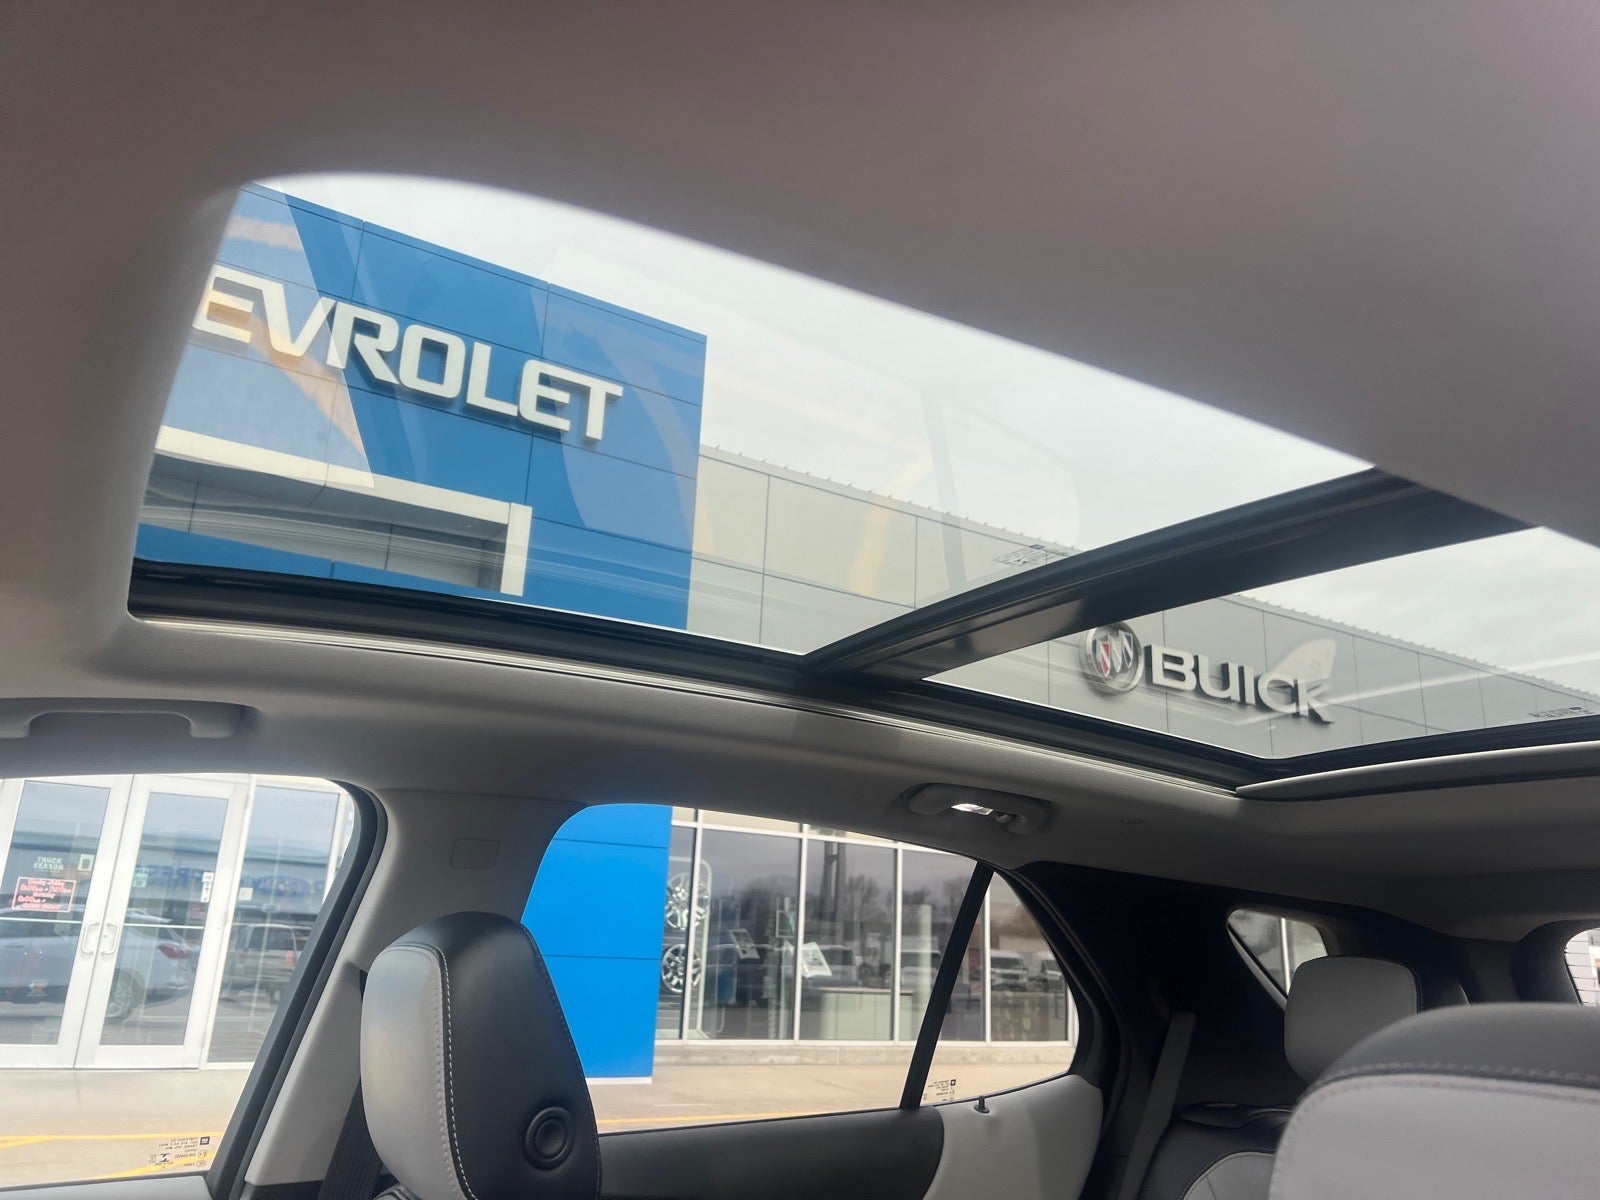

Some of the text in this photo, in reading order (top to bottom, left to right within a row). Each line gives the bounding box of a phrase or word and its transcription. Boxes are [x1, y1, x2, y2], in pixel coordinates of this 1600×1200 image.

[193, 264, 624, 441] EVROLET
[1145, 644, 1336, 725] BUICK
[33, 862, 64, 870] SEASON
[37, 856, 62, 864] TRUCK
